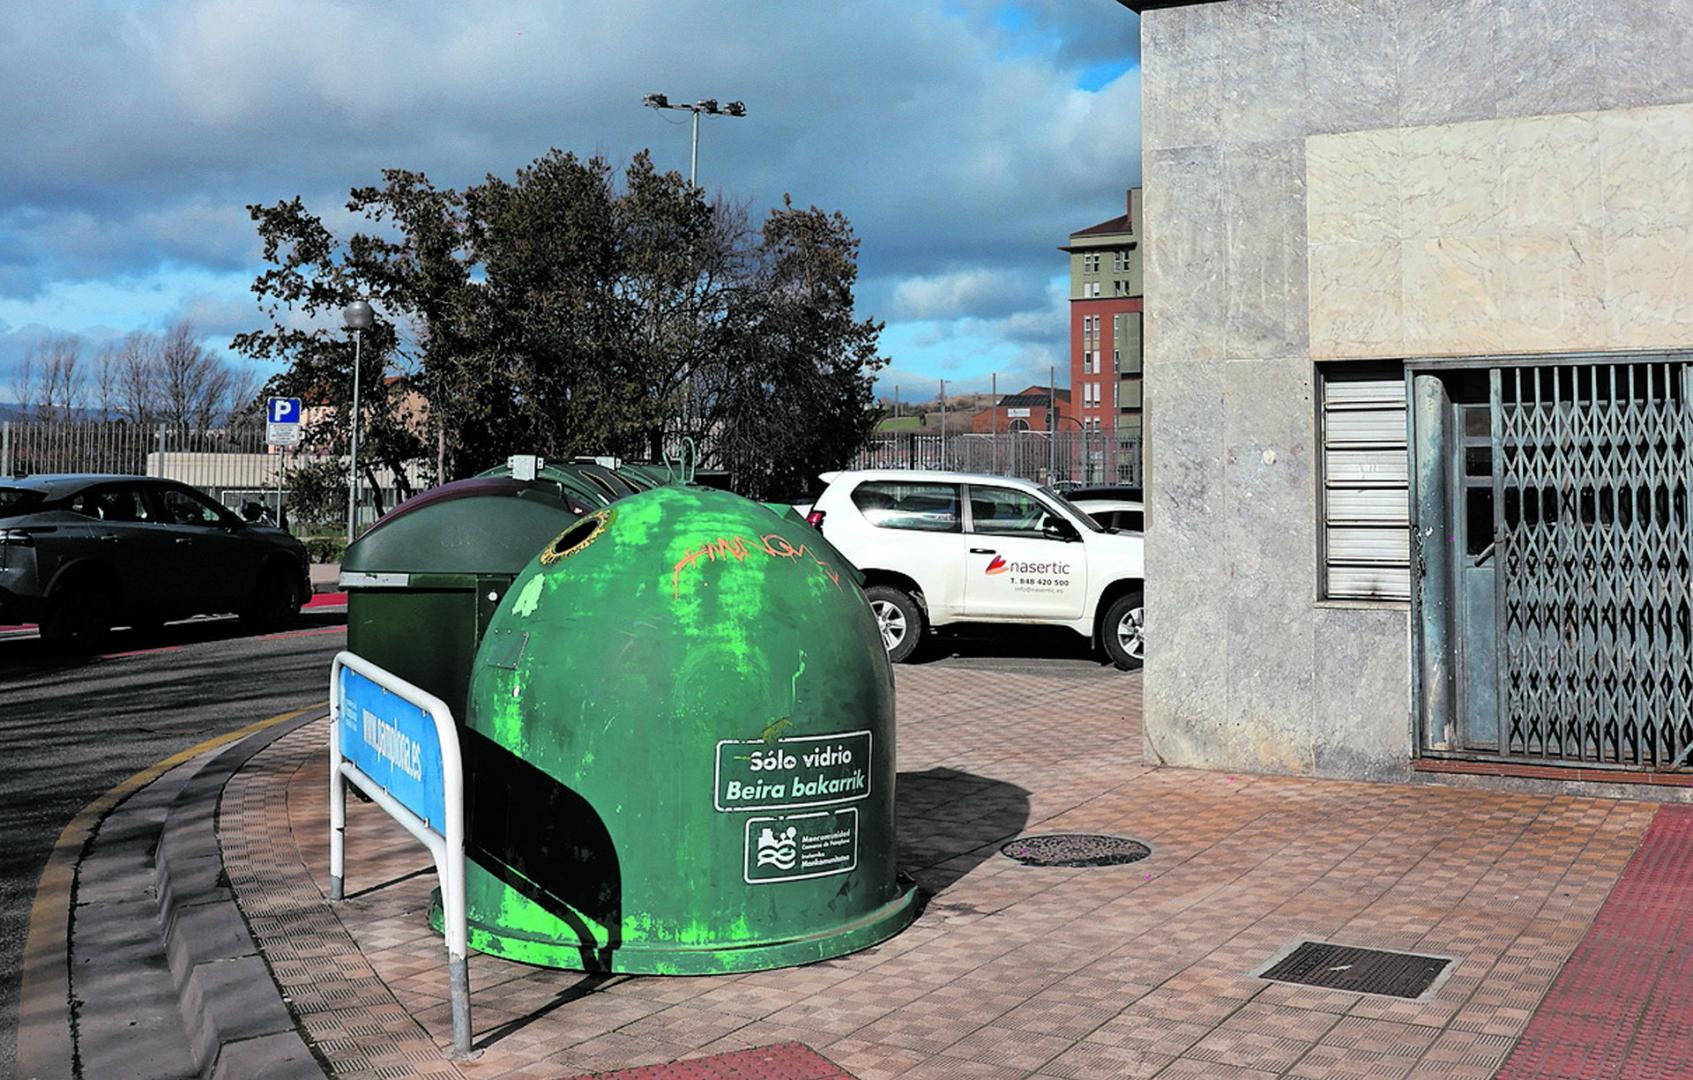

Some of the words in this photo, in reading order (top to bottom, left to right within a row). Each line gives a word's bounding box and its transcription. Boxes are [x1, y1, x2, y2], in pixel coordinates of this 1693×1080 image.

[275, 400, 292, 421] P
[1010, 560, 1070, 575] nasertic
[1037, 578, 1052, 586] 420
[1054, 579, 1070, 587] 500
[750, 749, 797, 771] Sólo
[802, 745, 852, 767] vidrio
[726, 779, 786, 800] Beira
[791, 769, 865, 797] bakarrik
